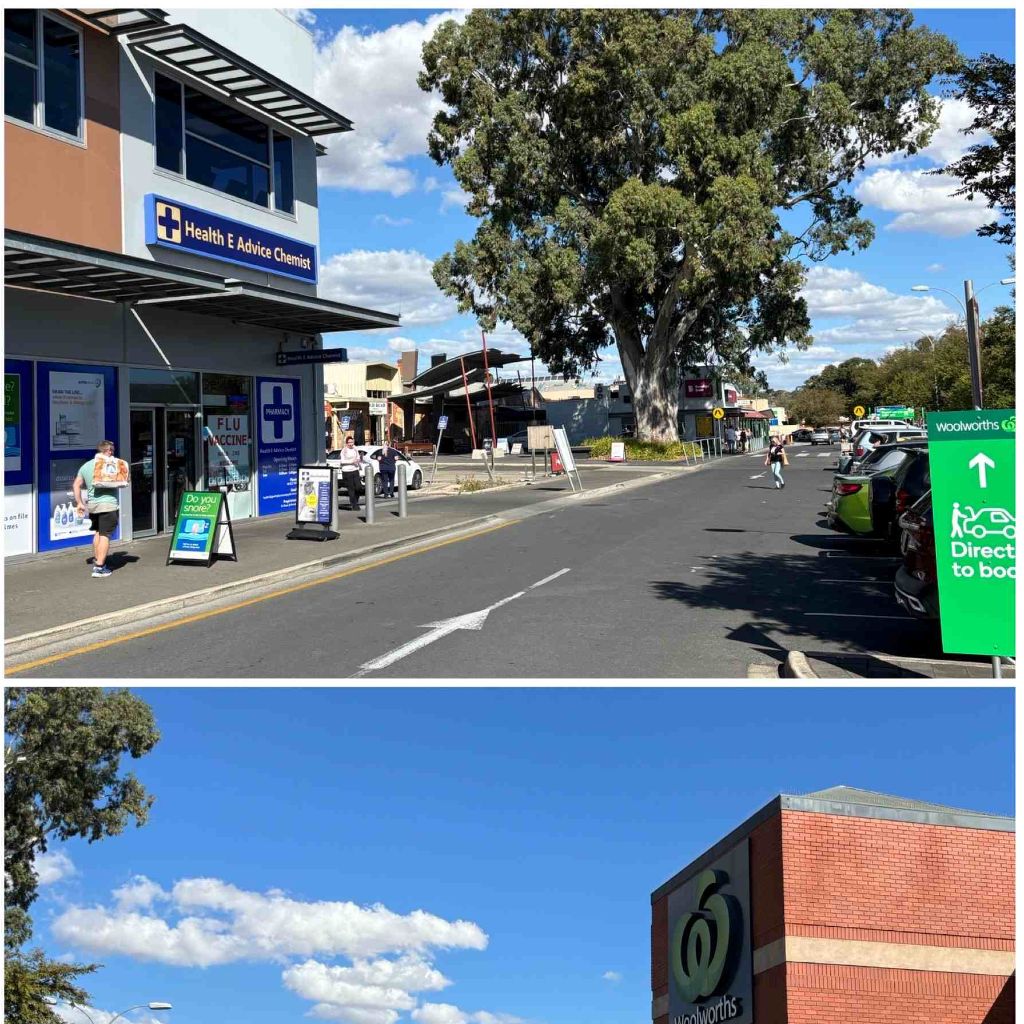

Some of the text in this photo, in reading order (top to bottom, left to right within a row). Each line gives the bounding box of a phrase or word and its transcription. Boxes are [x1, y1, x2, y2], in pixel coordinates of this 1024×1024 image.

[185, 220, 311, 270] Health E Advice Chemist
[217, 417, 241, 431] FLU
[208, 434, 248, 446] VACCINE
[186, 494, 217, 505] Do you
[183, 504, 212, 513] snore?
[951, 541, 1016, 558] Direct
[952, 562, 974, 577] to
